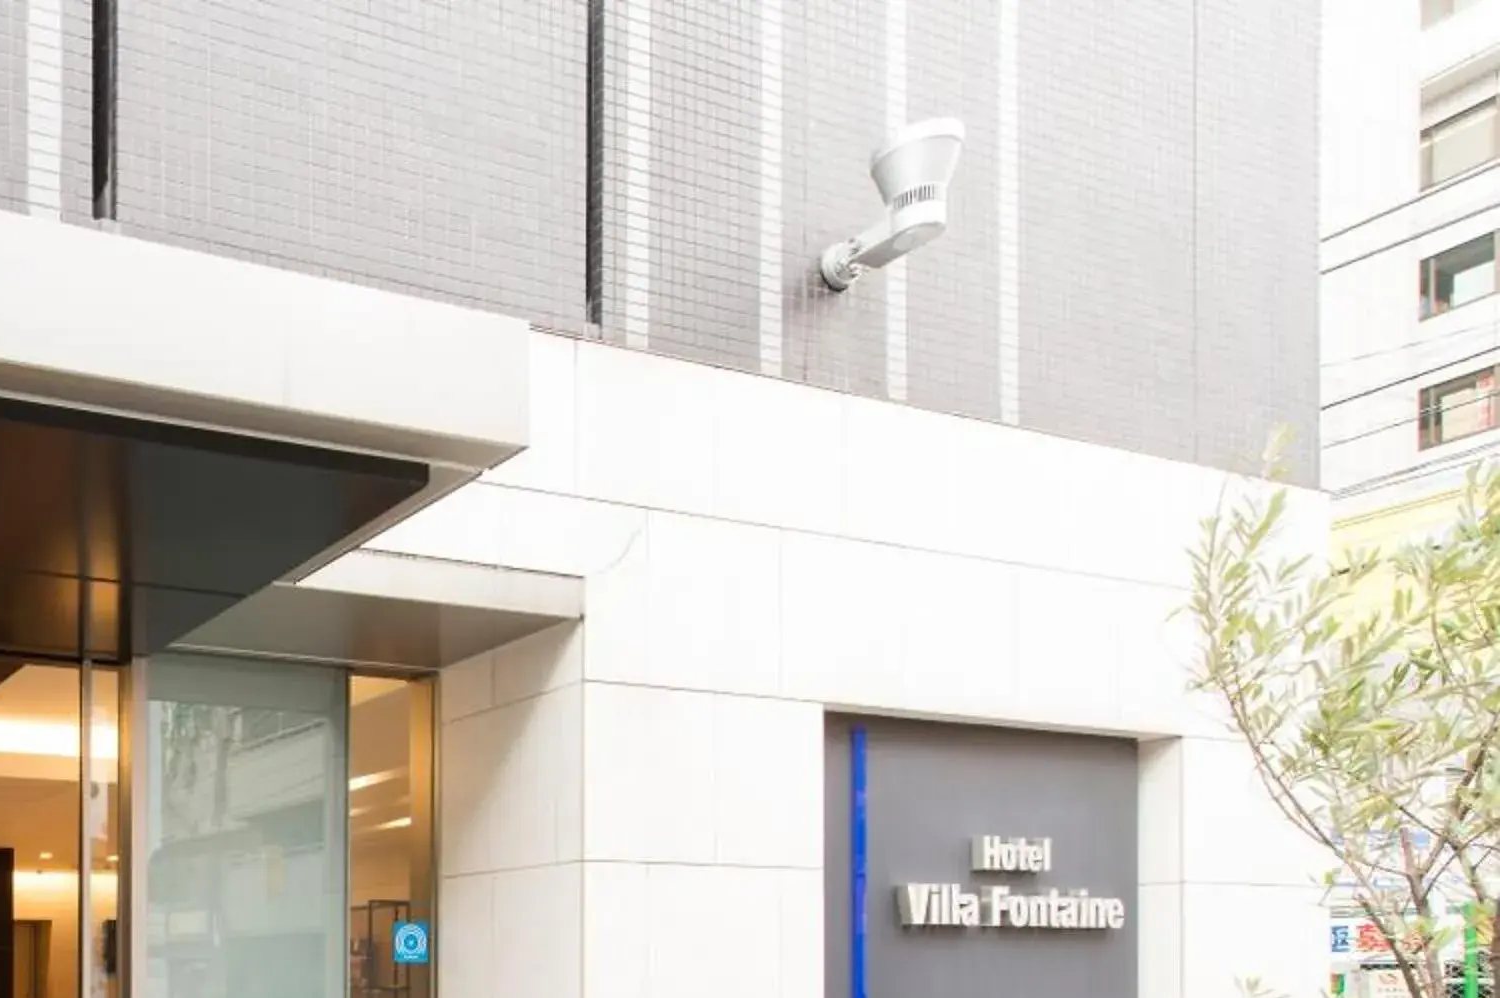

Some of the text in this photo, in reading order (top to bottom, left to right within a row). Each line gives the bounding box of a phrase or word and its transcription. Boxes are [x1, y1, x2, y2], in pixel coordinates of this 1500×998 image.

[976, 835, 1052, 872] Hotel
[902, 883, 1125, 929] Villa Fontaine
